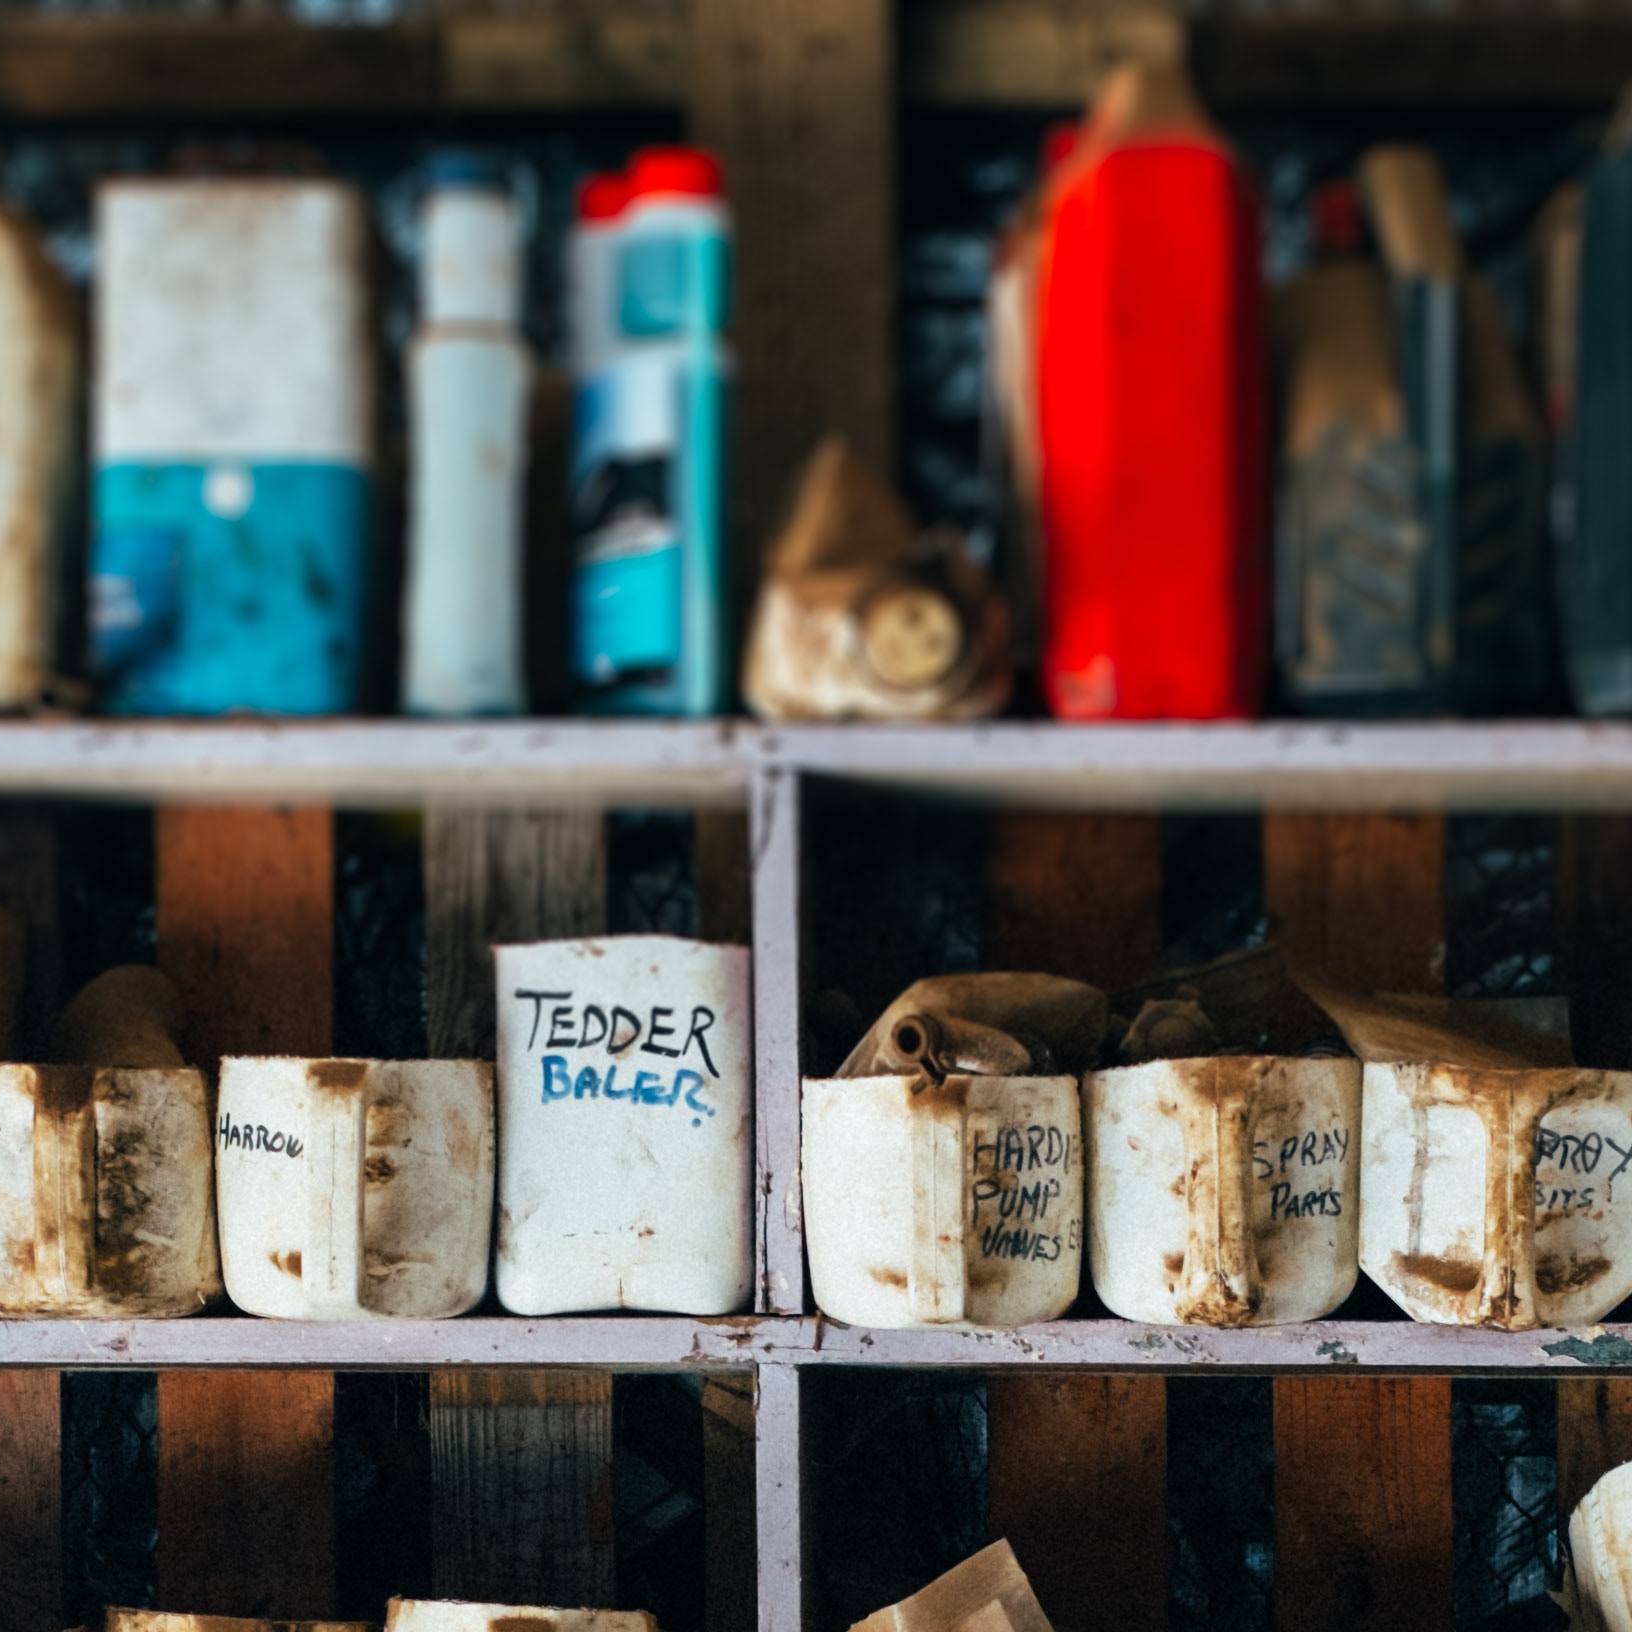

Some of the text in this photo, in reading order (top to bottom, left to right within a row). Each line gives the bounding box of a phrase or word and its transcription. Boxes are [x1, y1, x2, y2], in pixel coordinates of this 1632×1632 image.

[514, 988, 721, 1077] TEDDER
[218, 1112, 305, 1159] HARROW
[1253, 1127, 1350, 1179] SPRAY
[972, 1178, 1061, 1229] PUMP
[1270, 1181, 1343, 1220] PARTS
